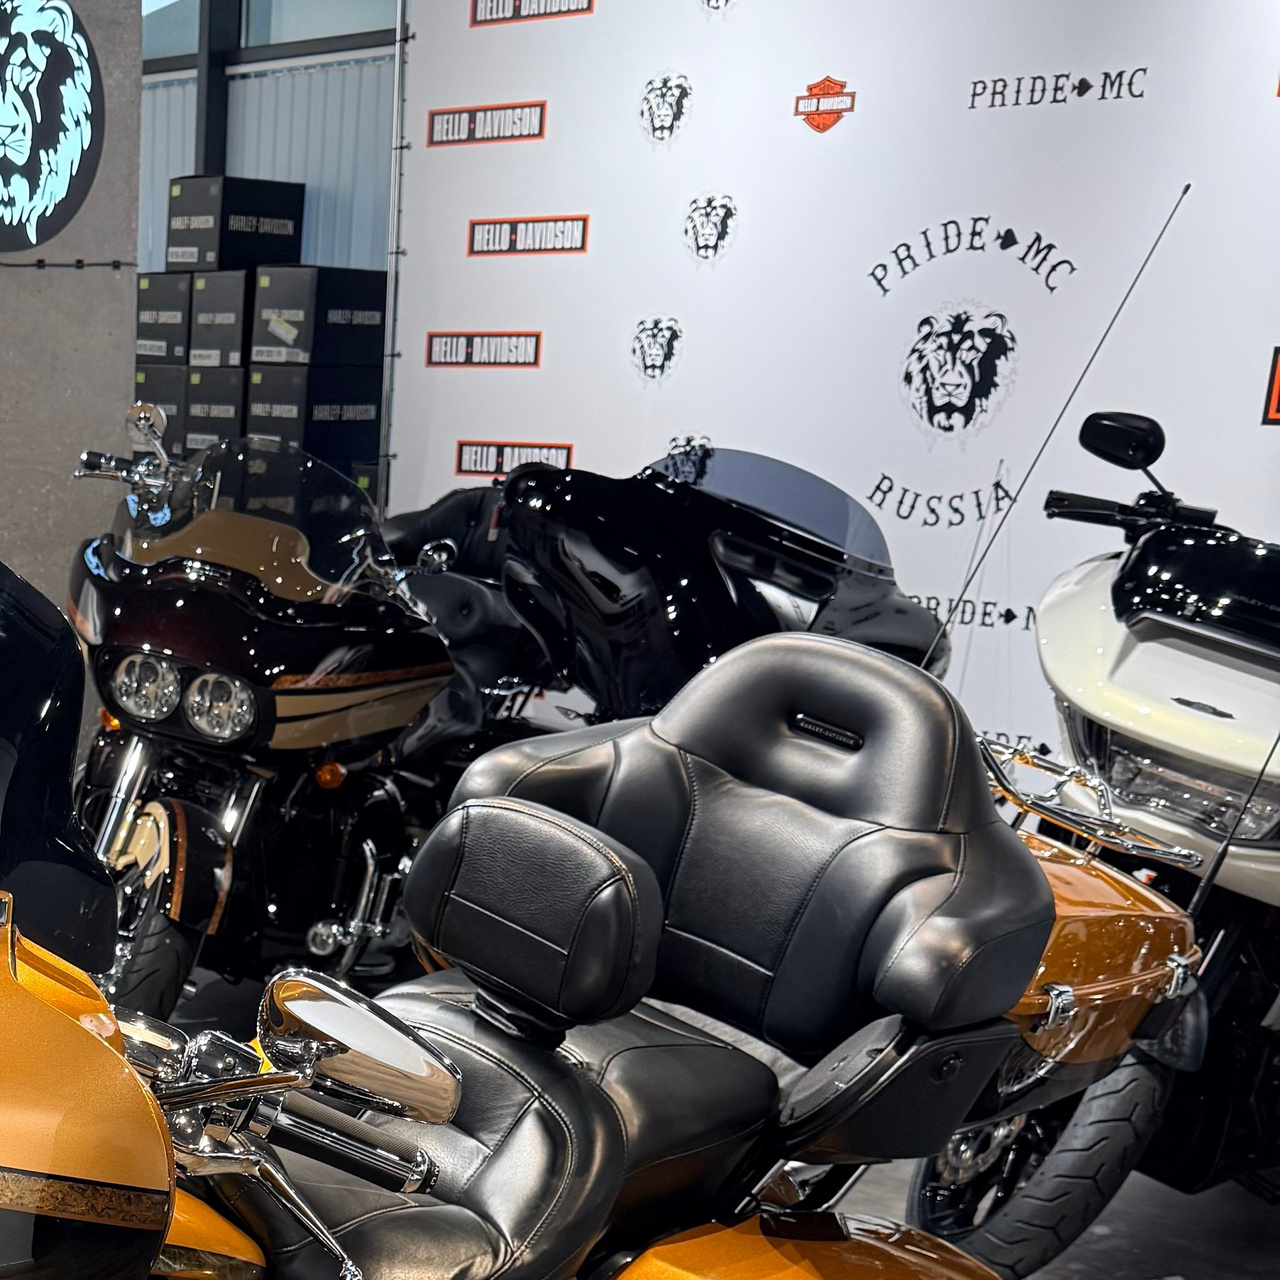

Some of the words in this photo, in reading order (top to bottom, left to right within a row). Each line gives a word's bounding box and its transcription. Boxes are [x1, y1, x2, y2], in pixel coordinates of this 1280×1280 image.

[968, 71, 1071, 109] PRIDE
[1097, 67, 1148, 100] MC
[433, 112, 469, 142] HELLO
[475, 106, 541, 139] DAVIDSON
[228, 214, 294, 236] HARLEY-DAVIDSON
[473, 223, 510, 252] HELLO
[516, 220, 583, 250] DAVIDSON
[867, 215, 991, 298] PRIDE
[1016, 231, 1078, 294] MC
[431, 336, 467, 363] HELLO
[472, 336, 537, 364] DAVIDSON
[461, 445, 497, 472] HELLO
[866, 472, 1017, 528] RUSSIA
